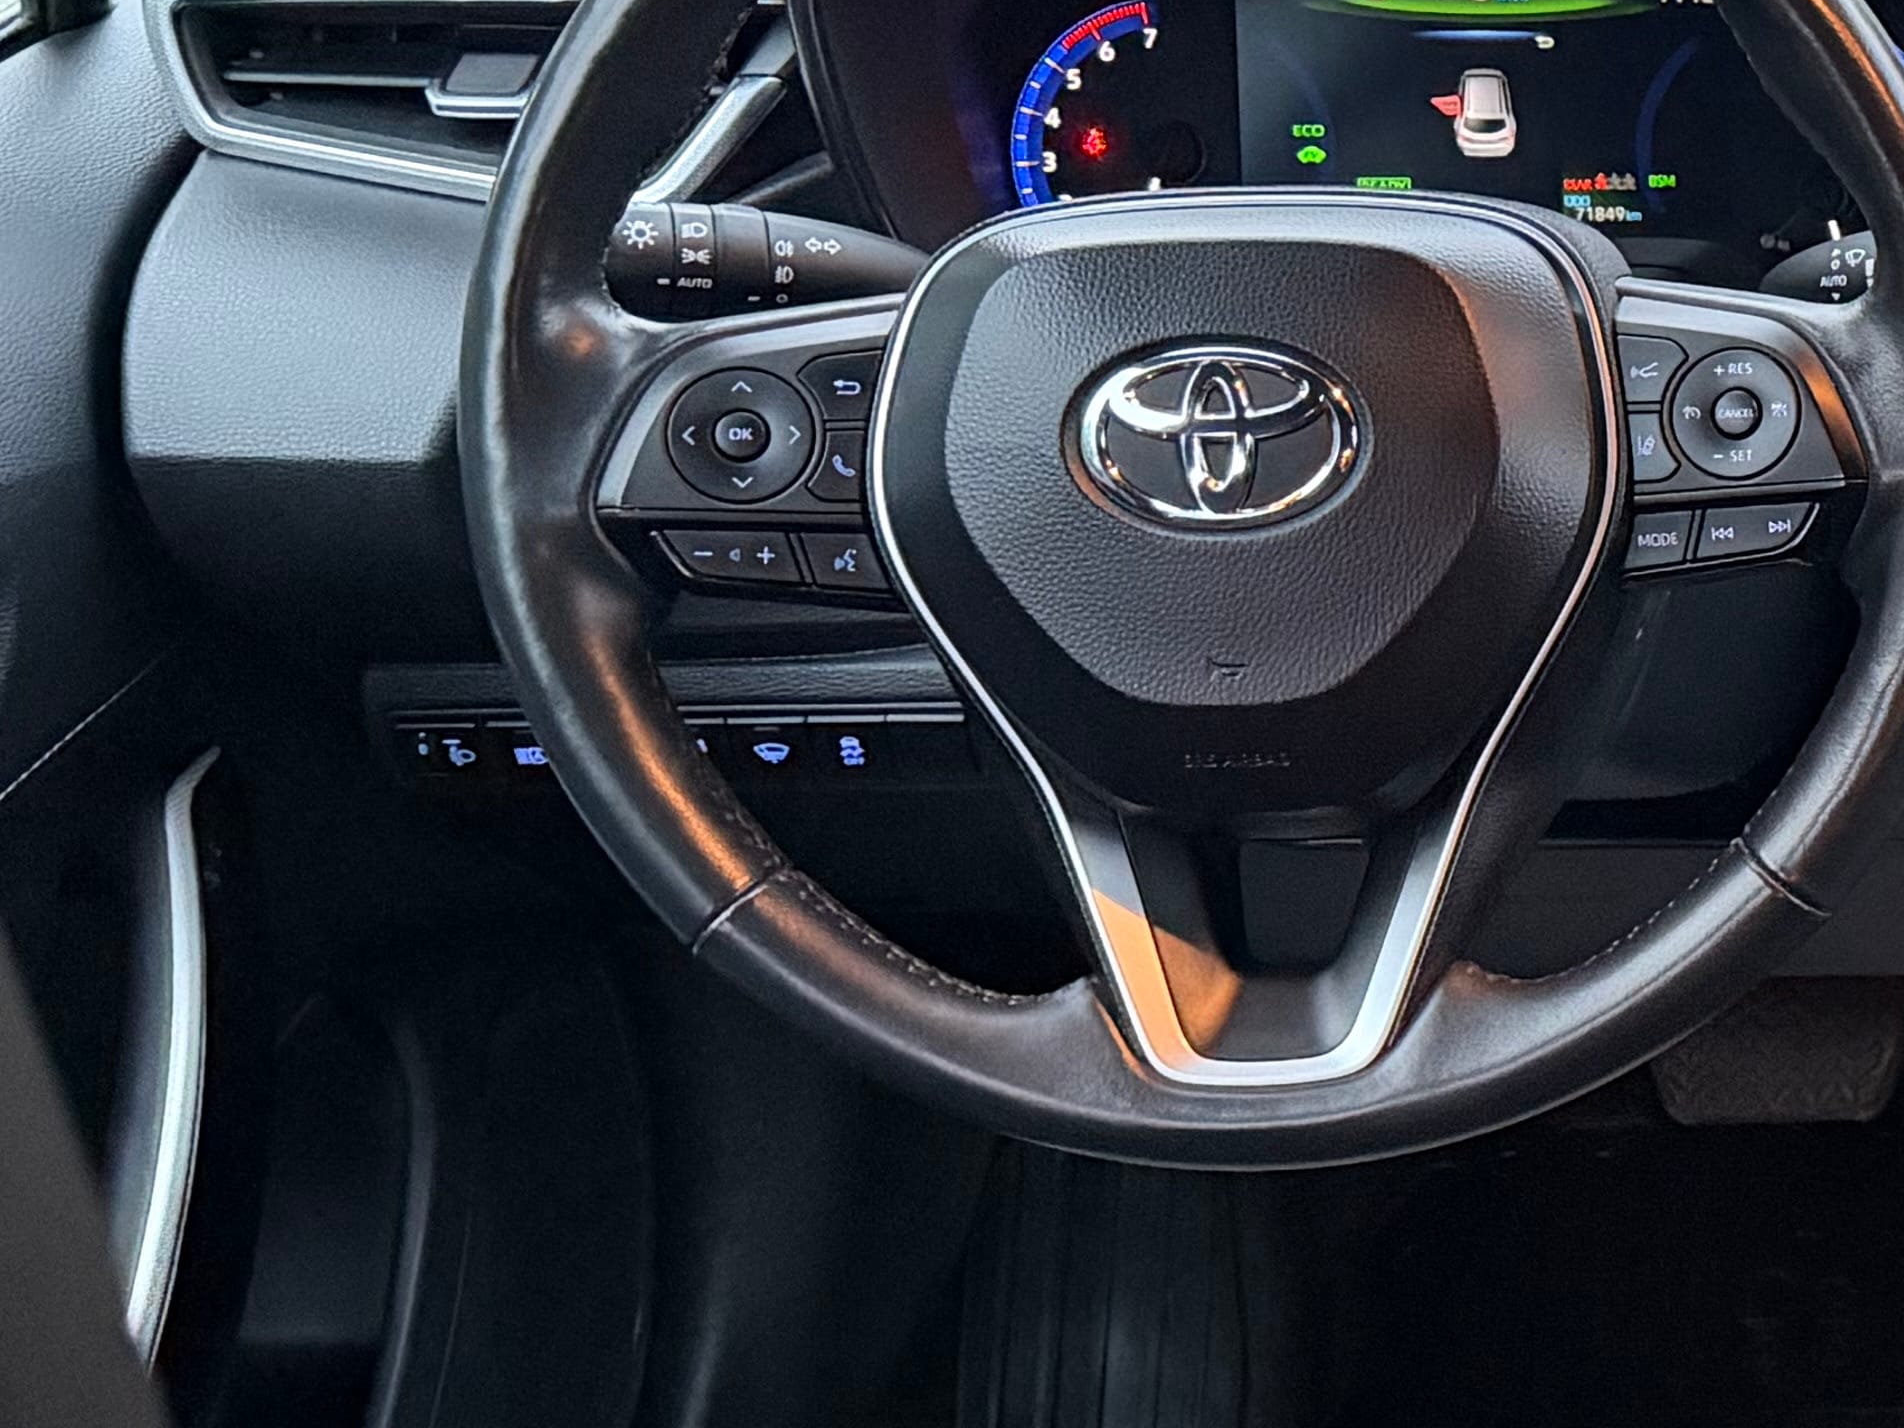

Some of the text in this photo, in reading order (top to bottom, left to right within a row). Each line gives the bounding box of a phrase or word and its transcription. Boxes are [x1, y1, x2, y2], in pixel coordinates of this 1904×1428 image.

[1143, 28, 1158, 48] 7
[1099, 41, 1116, 62] 6
[1066, 68, 1082, 90] 5
[1044, 107, 1061, 128] 4
[1292, 124, 1325, 138] ECO
[1042, 151, 1057, 173] 3
[1575, 206, 1625, 222] 71849
[677, 276, 712, 289] AUTO
[1820, 274, 1848, 288] AUTO
[1718, 406, 1754, 419] CANCEL
[728, 427, 753, 441] OK
[1637, 532, 1679, 548] MODE
